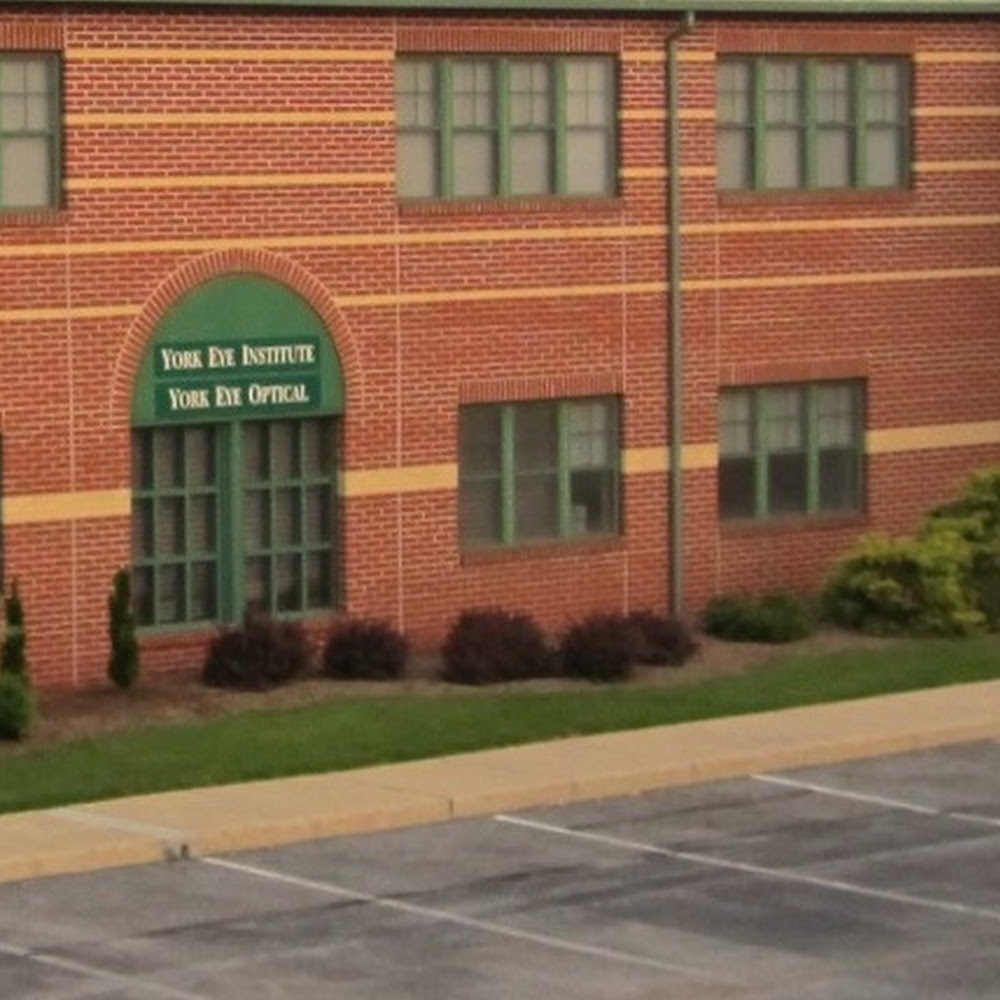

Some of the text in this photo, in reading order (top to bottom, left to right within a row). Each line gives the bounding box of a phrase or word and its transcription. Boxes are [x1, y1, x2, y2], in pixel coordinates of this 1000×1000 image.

[161, 344, 315, 370] YORK EYE INSTITUTE
[168, 383, 310, 410] YORK EYE OPTICAL
